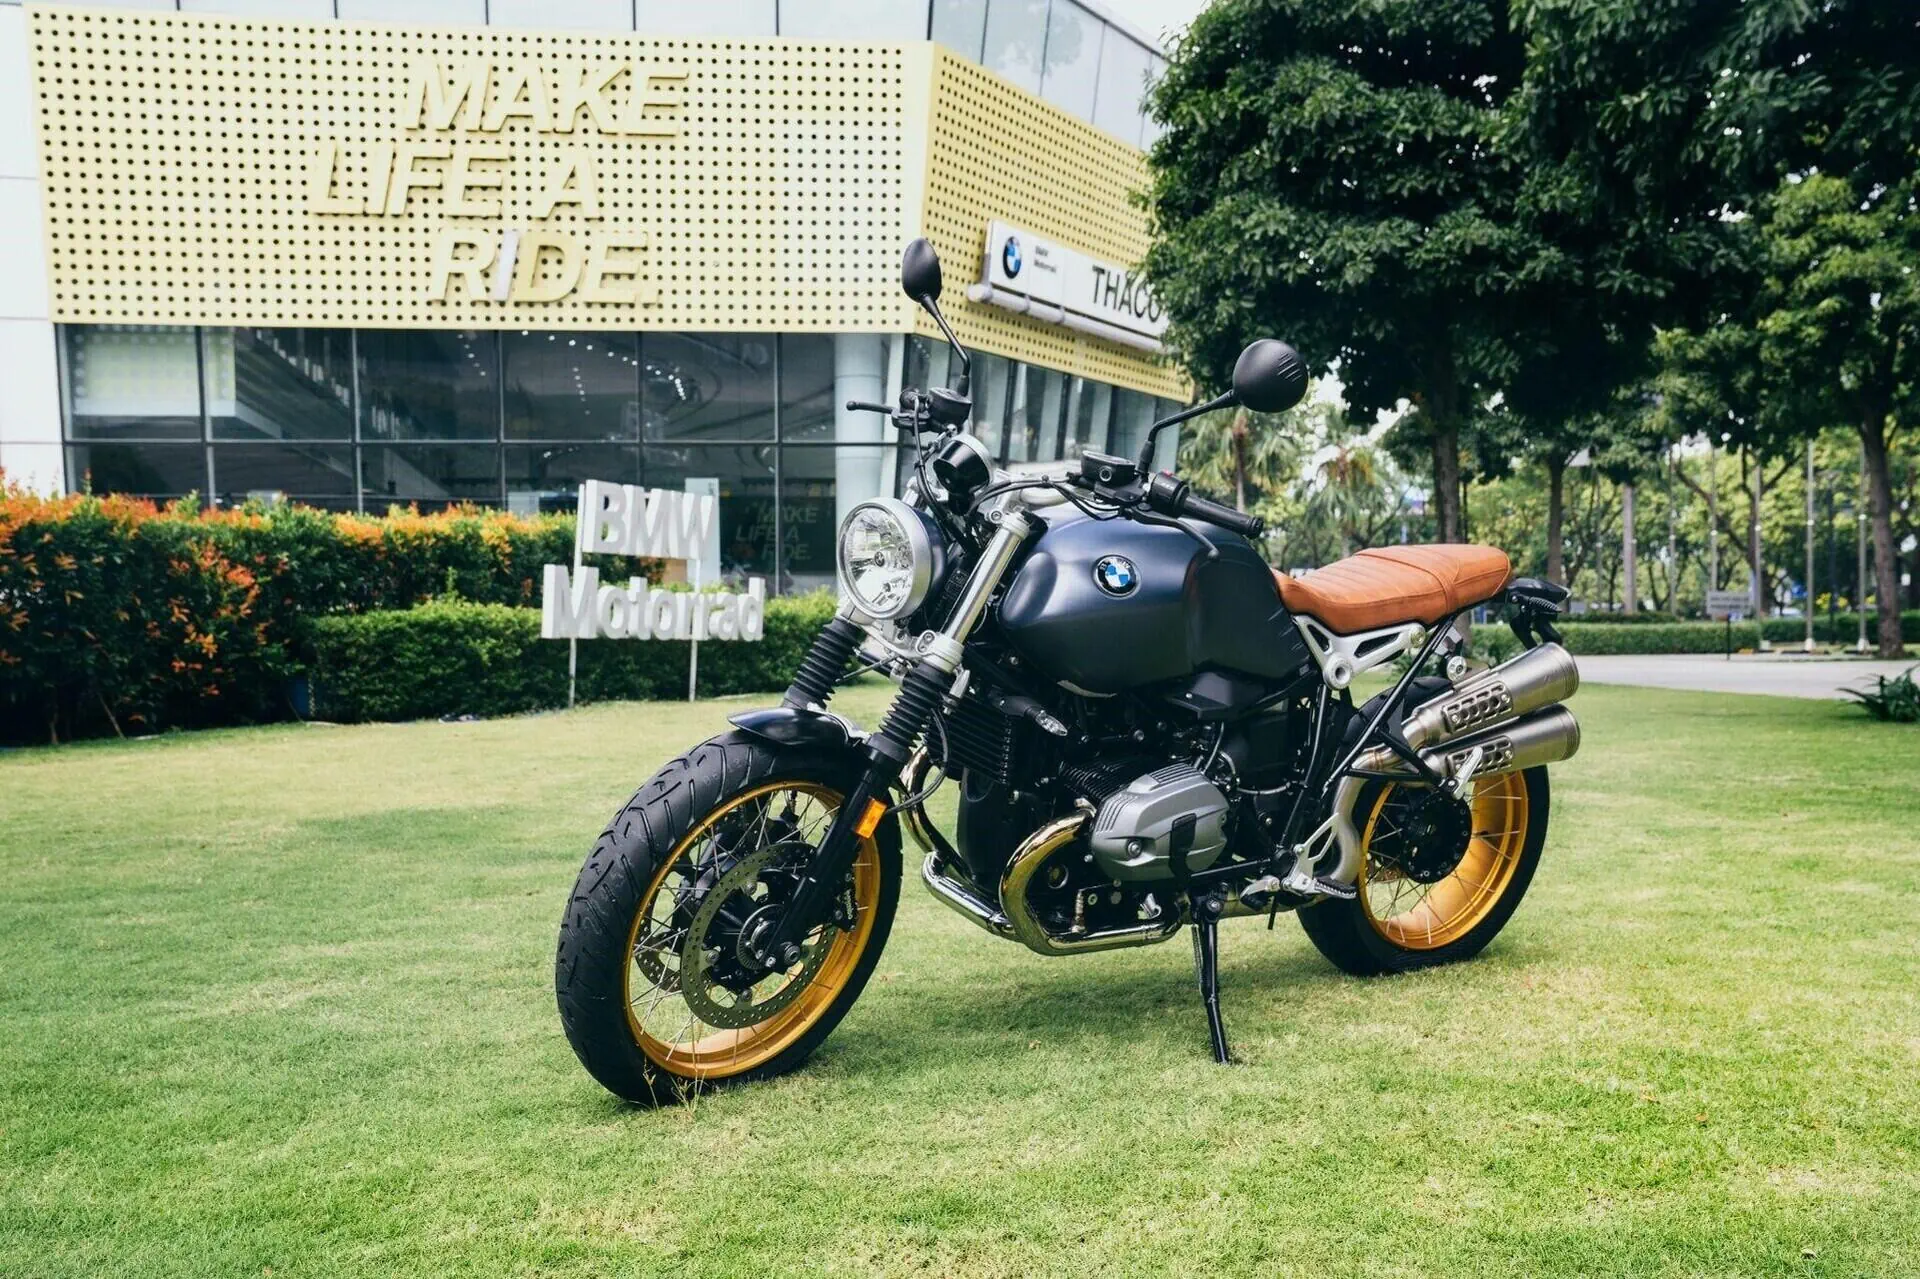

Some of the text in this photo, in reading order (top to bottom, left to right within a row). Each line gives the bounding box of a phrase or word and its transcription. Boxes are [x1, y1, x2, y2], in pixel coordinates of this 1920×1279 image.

[403, 61, 690, 137] MAKE
[309, 140, 604, 221] LIFE A
[430, 228, 662, 307] RIDE.
[582, 479, 714, 560] BMW
[541, 564, 766, 643] Motorrad
